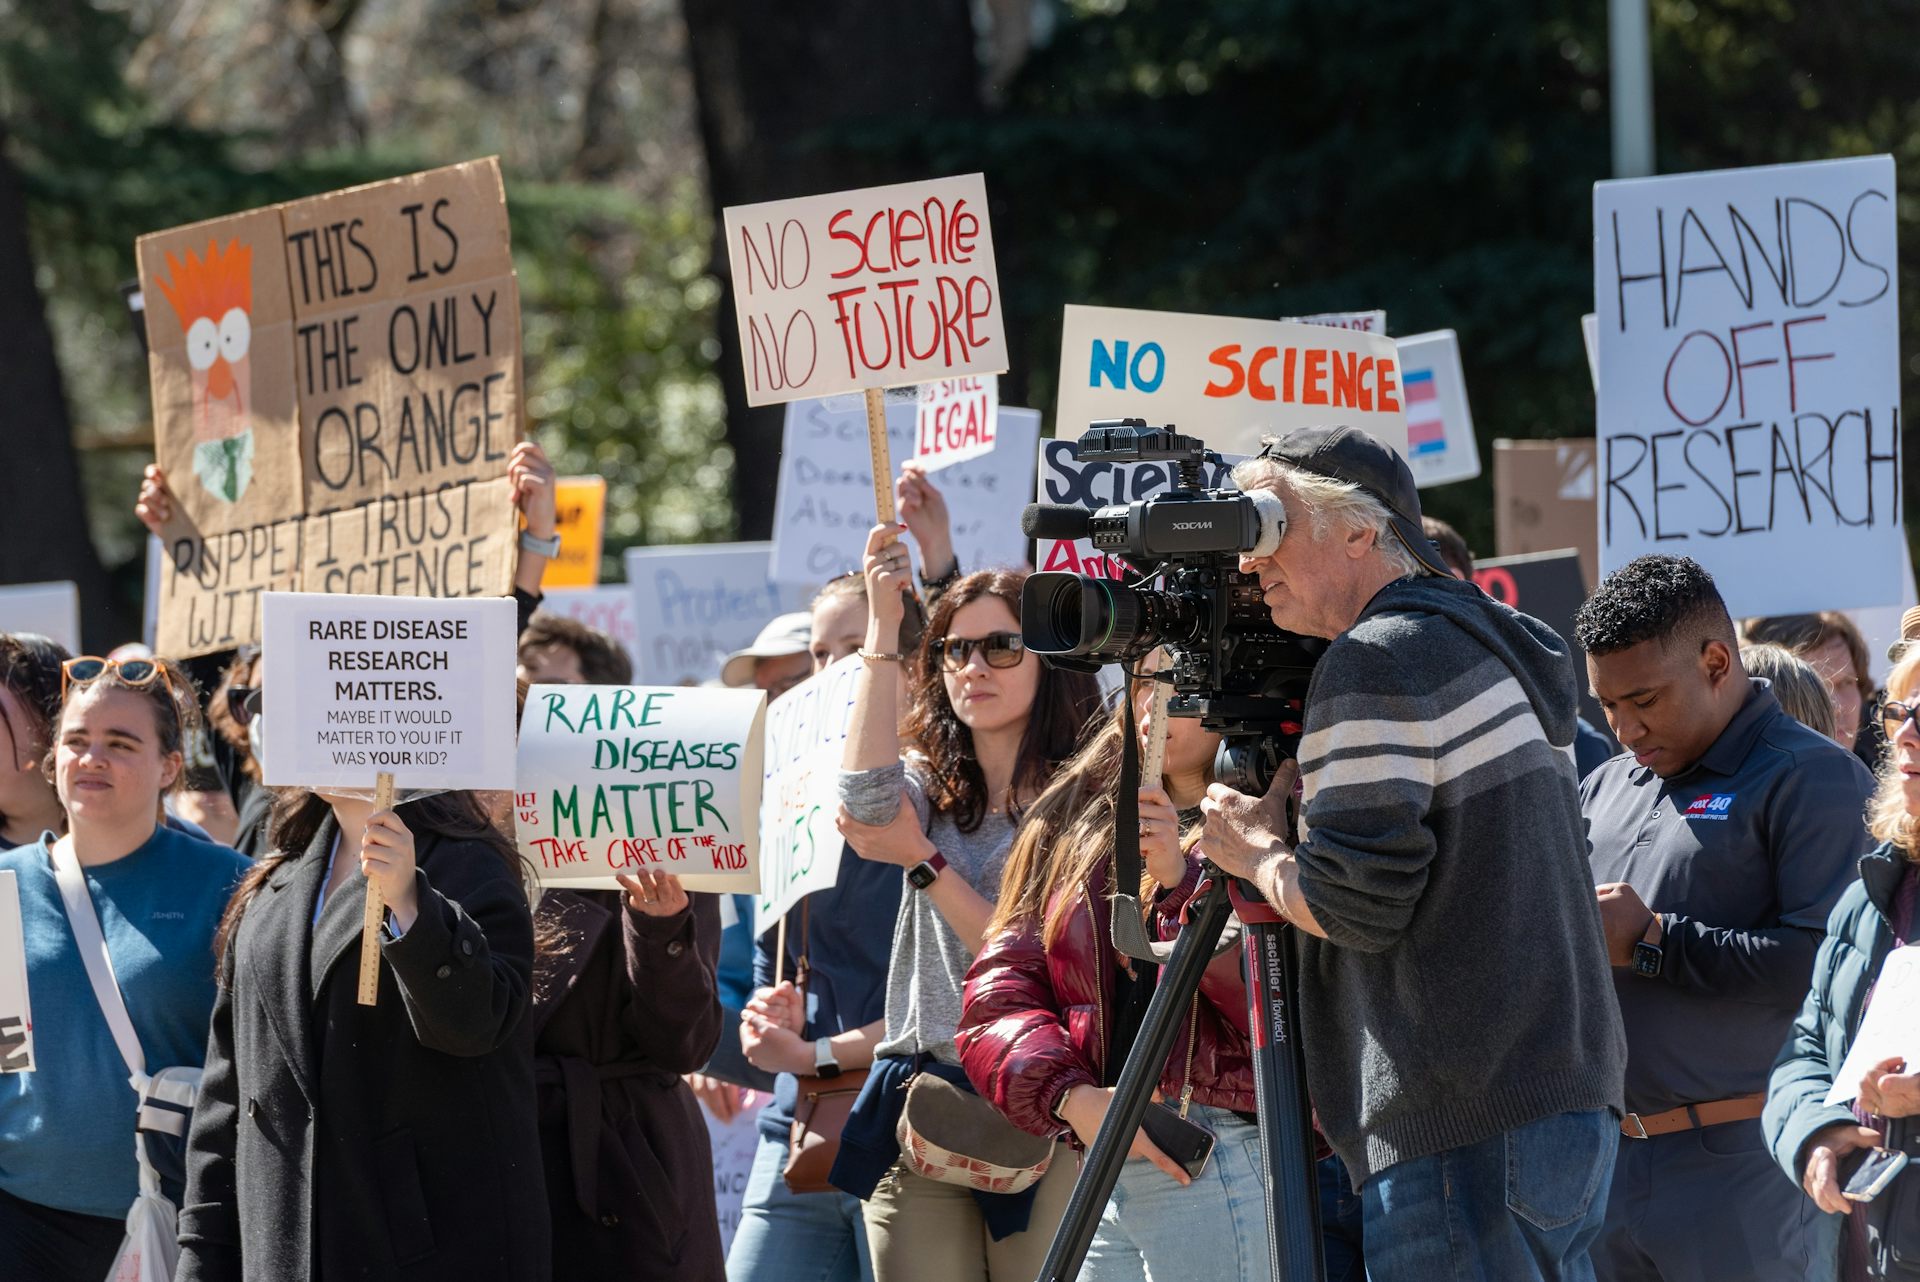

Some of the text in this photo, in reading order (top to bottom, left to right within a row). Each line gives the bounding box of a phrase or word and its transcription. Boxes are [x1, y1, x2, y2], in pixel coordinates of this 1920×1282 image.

[288, 199, 459, 305] THIS IS
[742, 218, 811, 295] NO
[1612, 189, 1890, 333] HANDS
[298, 290, 497, 395] THE ONLY
[748, 309, 817, 392] NO
[1664, 315, 1836, 427] OFF
[1089, 339, 1400, 413] NO SCIENCE
[314, 372, 506, 490] ORANGE
[920, 394, 994, 456] LEGAL
[1606, 407, 1899, 547] RESEARCH
[171, 477, 477, 598] PUPPET I TRUST
[1172, 520, 1213, 530] XDCAM
[188, 577, 296, 649] WIT
[309, 620, 469, 641] RARE DISEASE
[328, 651, 449, 671] RESEARCH
[335, 681, 444, 701] MATTERS.
[317, 730, 463, 745] MATTER TO YOU IF IT
[327, 710, 452, 725] MAYBE IT WOULD
[541, 688, 676, 735] RARE
[332, 751, 448, 766] WAS YOUR KID?
[591, 738, 743, 773] DISEASES
[520, 810, 539, 825] US
[551, 778, 730, 839] MATTER
[1688, 797, 1732, 811] FOX 40
[529, 834, 748, 870] TAKE CARE OF THE KIDS
[1266, 933, 1286, 1043] sachtler flowtech
